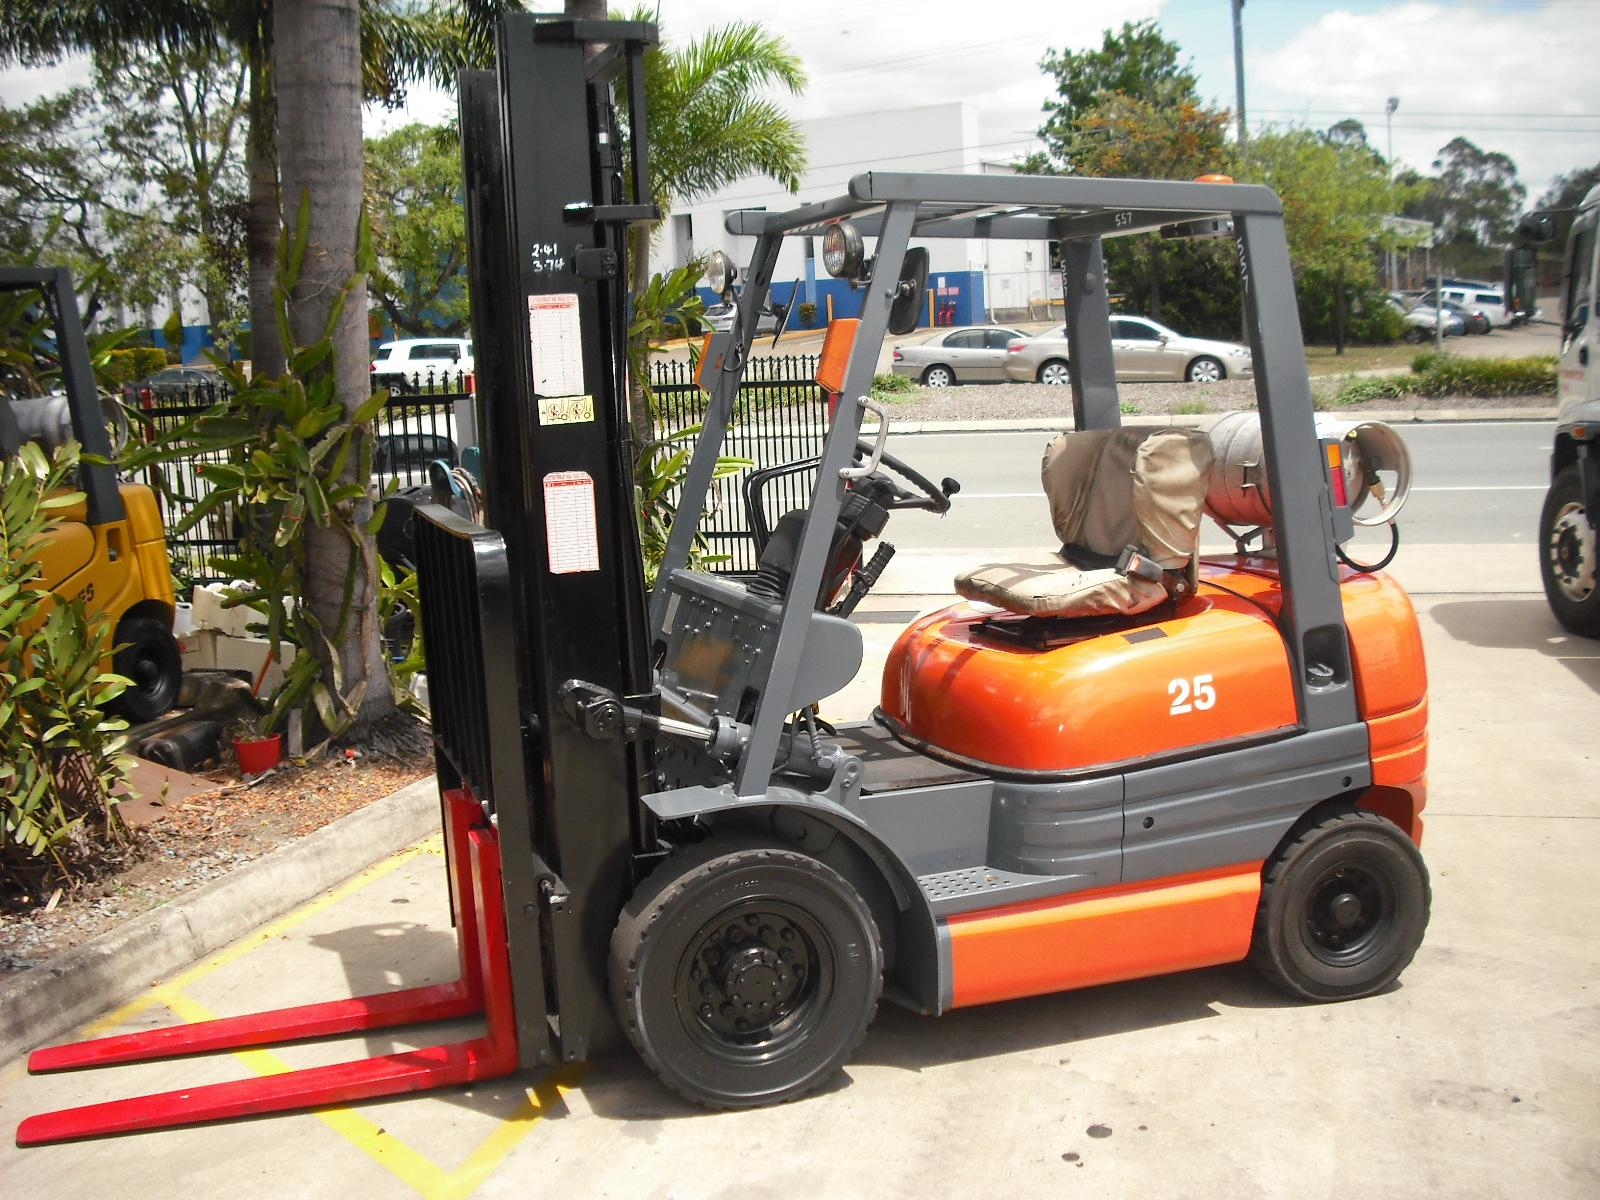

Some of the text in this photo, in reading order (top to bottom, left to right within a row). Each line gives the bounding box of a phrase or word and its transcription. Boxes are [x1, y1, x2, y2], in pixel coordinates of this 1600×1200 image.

[1115, 212, 1132, 227] 557
[531, 243, 558, 258] 2.41
[532, 257, 565, 272] 3.74
[1168, 673, 1217, 716] 25
